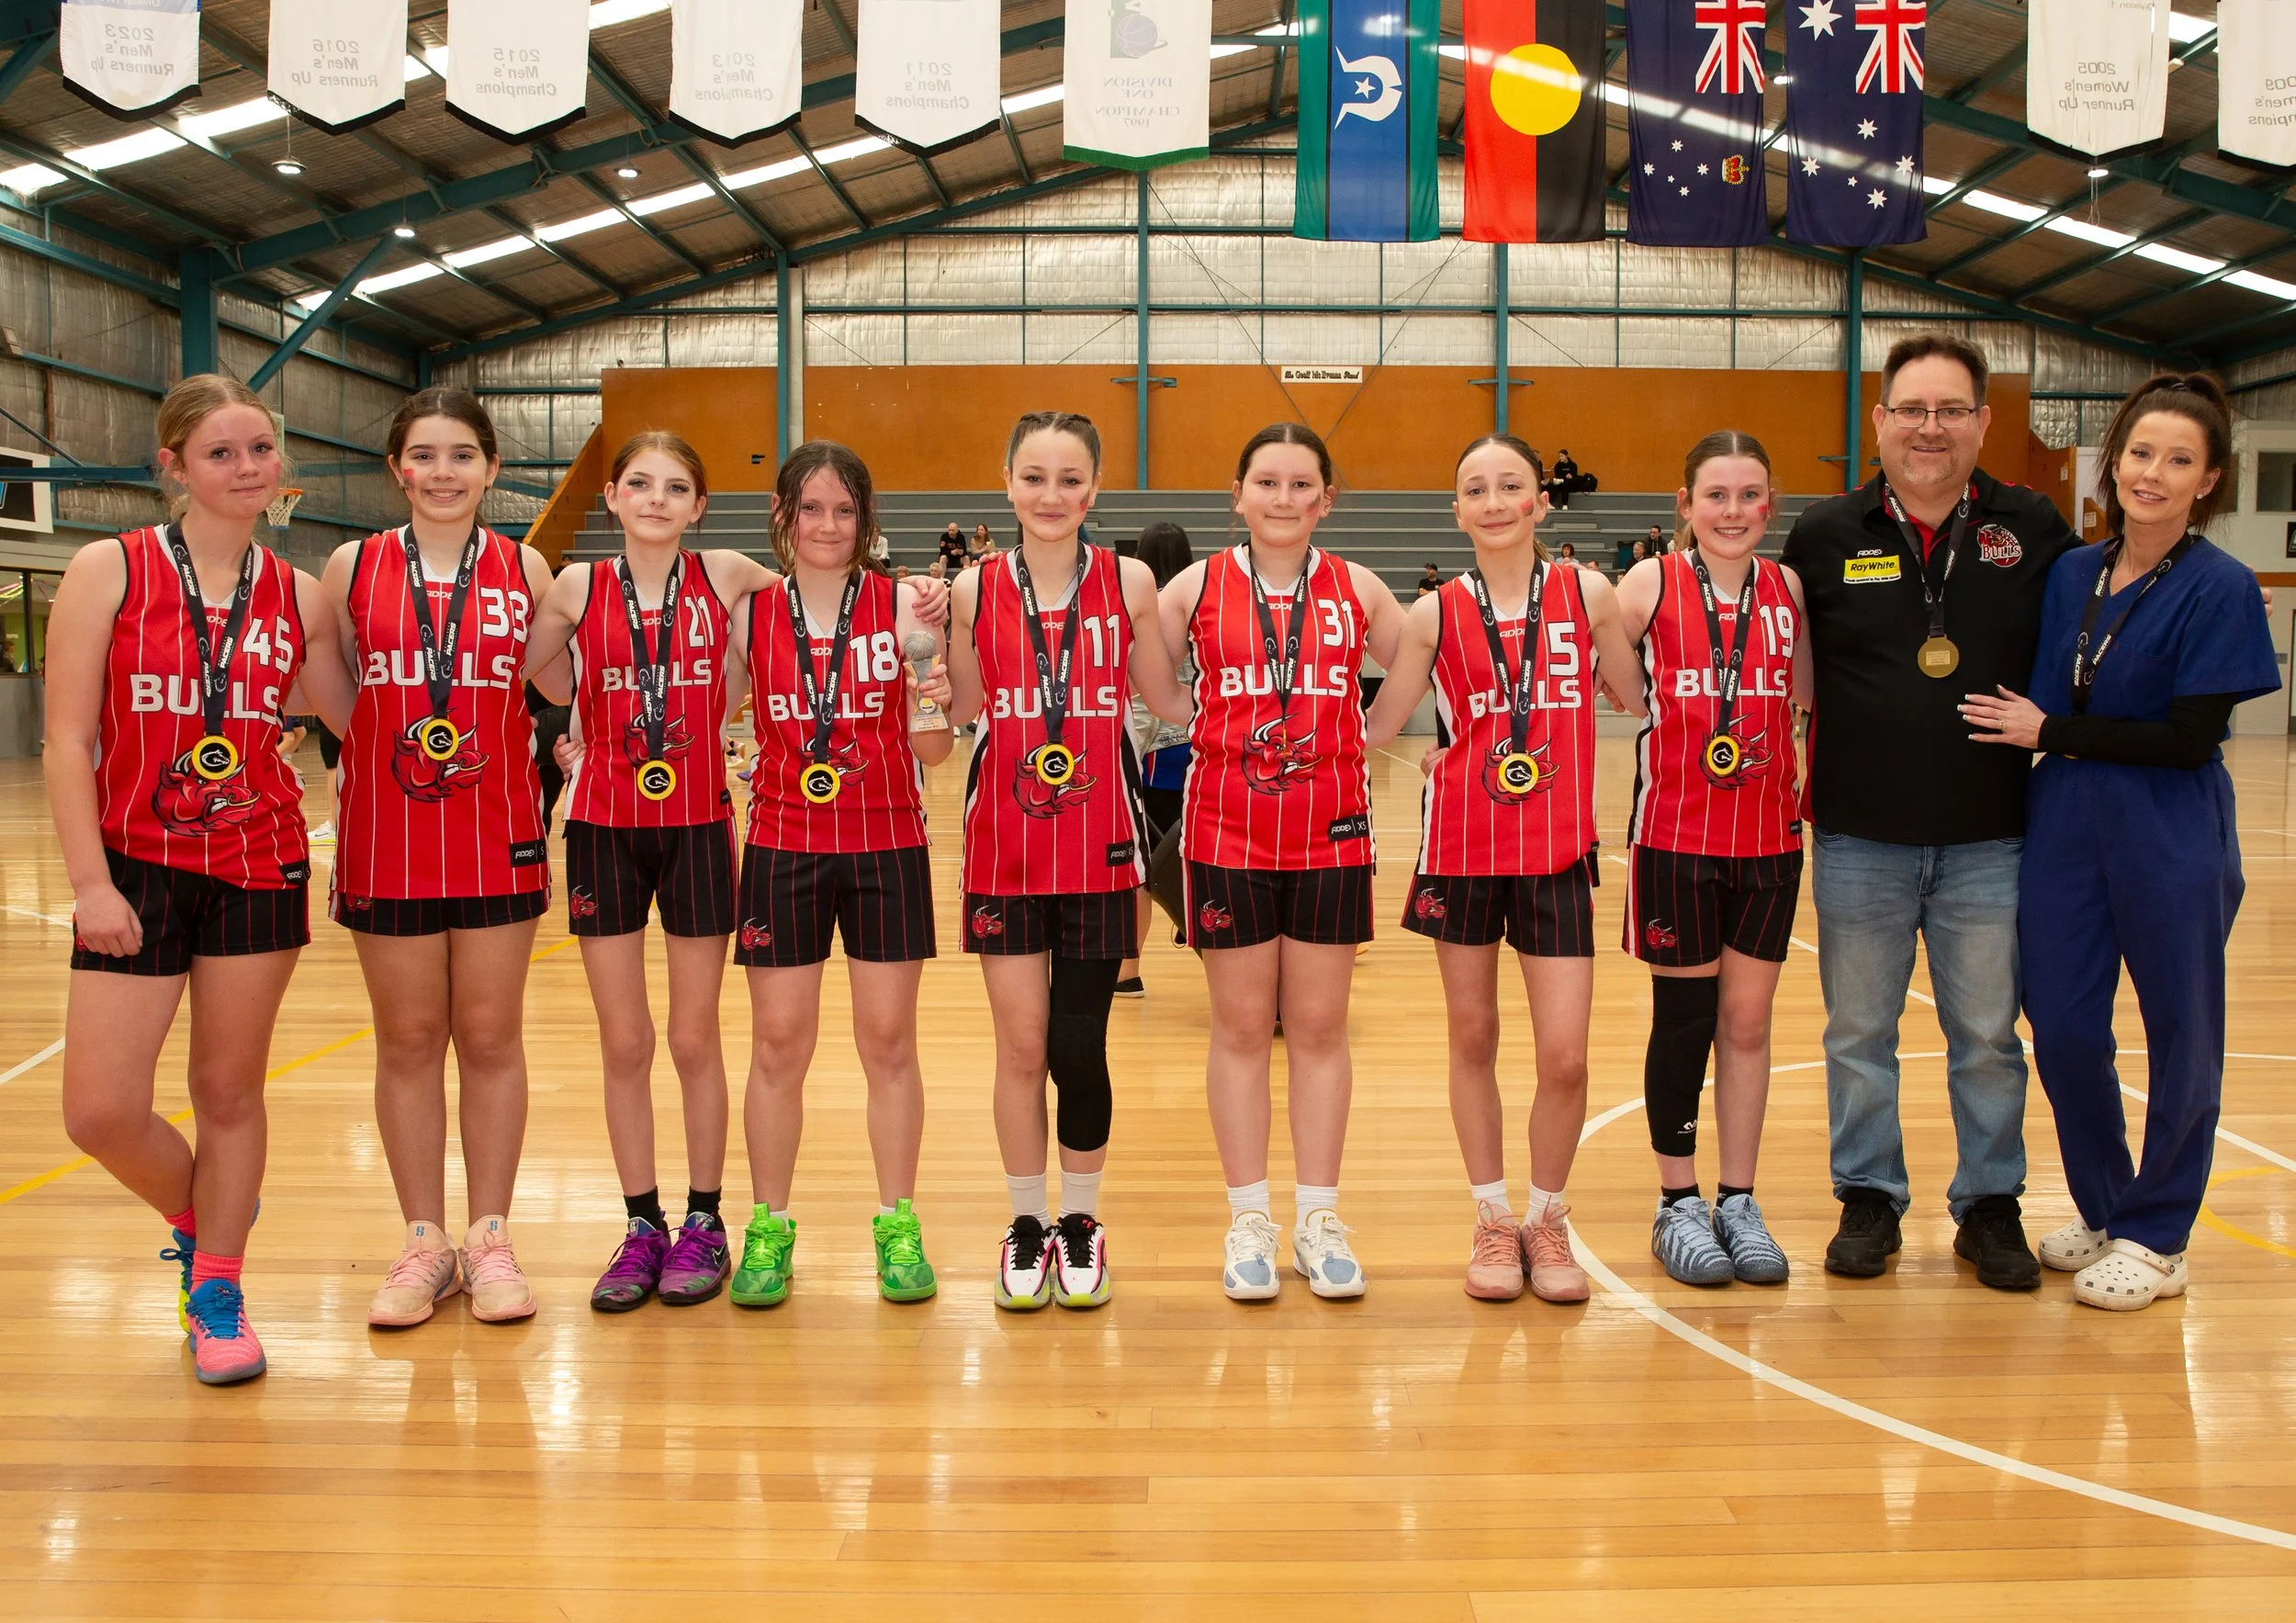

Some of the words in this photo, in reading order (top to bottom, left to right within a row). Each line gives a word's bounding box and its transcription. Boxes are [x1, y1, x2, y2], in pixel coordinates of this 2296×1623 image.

[1888, 497, 1907, 523] PACERS
[466, 544, 476, 570] PACERS
[1979, 544, 2023, 562] BULLS
[182, 563, 197, 597] PACERS
[410, 560, 421, 588] PACERS
[668, 575, 678, 606] PACERS
[1532, 573, 1541, 603] PACERS
[2095, 566, 2109, 597] PACERS
[790, 589, 801, 618] PACERS
[843, 585, 856, 615] PACERS
[1023, 586, 1035, 616] PACERS
[1476, 579, 1488, 607] PACERS
[1702, 582, 1715, 613] PACERS
[1741, 586, 1750, 614] PACERS
[480, 587, 529, 644] 33
[627, 599, 640, 630] PACERS
[683, 595, 715, 648] 21
[1317, 599, 1356, 648] 31
[242, 615, 294, 675] 45
[446, 622, 457, 658] PACERS
[1083, 614, 1120, 668] 11
[1759, 605, 1794, 658] 19
[219, 637, 234, 670] PACERS
[425, 647, 437, 682] PACERS
[849, 629, 899, 683] 18
[1060, 648, 1070, 683] PACERS
[1548, 622, 1580, 676] 5
[2092, 633, 2112, 666] PACERS
[363, 649, 516, 690] BULS
[657, 664, 666, 699] PACERS
[1270, 657, 1281, 691] PACERS
[1286, 657, 1295, 690] PACERS
[1522, 659, 1532, 693] PACERS
[1726, 669, 1738, 702] PACERS
[2073, 653, 2083, 687] PACERS
[129, 673, 280, 726] BULS
[805, 673, 816, 705] PACERS
[827, 671, 838, 704] PACERS
[992, 685, 1118, 719] BULS
[1041, 674, 1052, 708] PACERS
[644, 690, 653, 723] PACERS
[1356, 820, 1367, 830] XS
